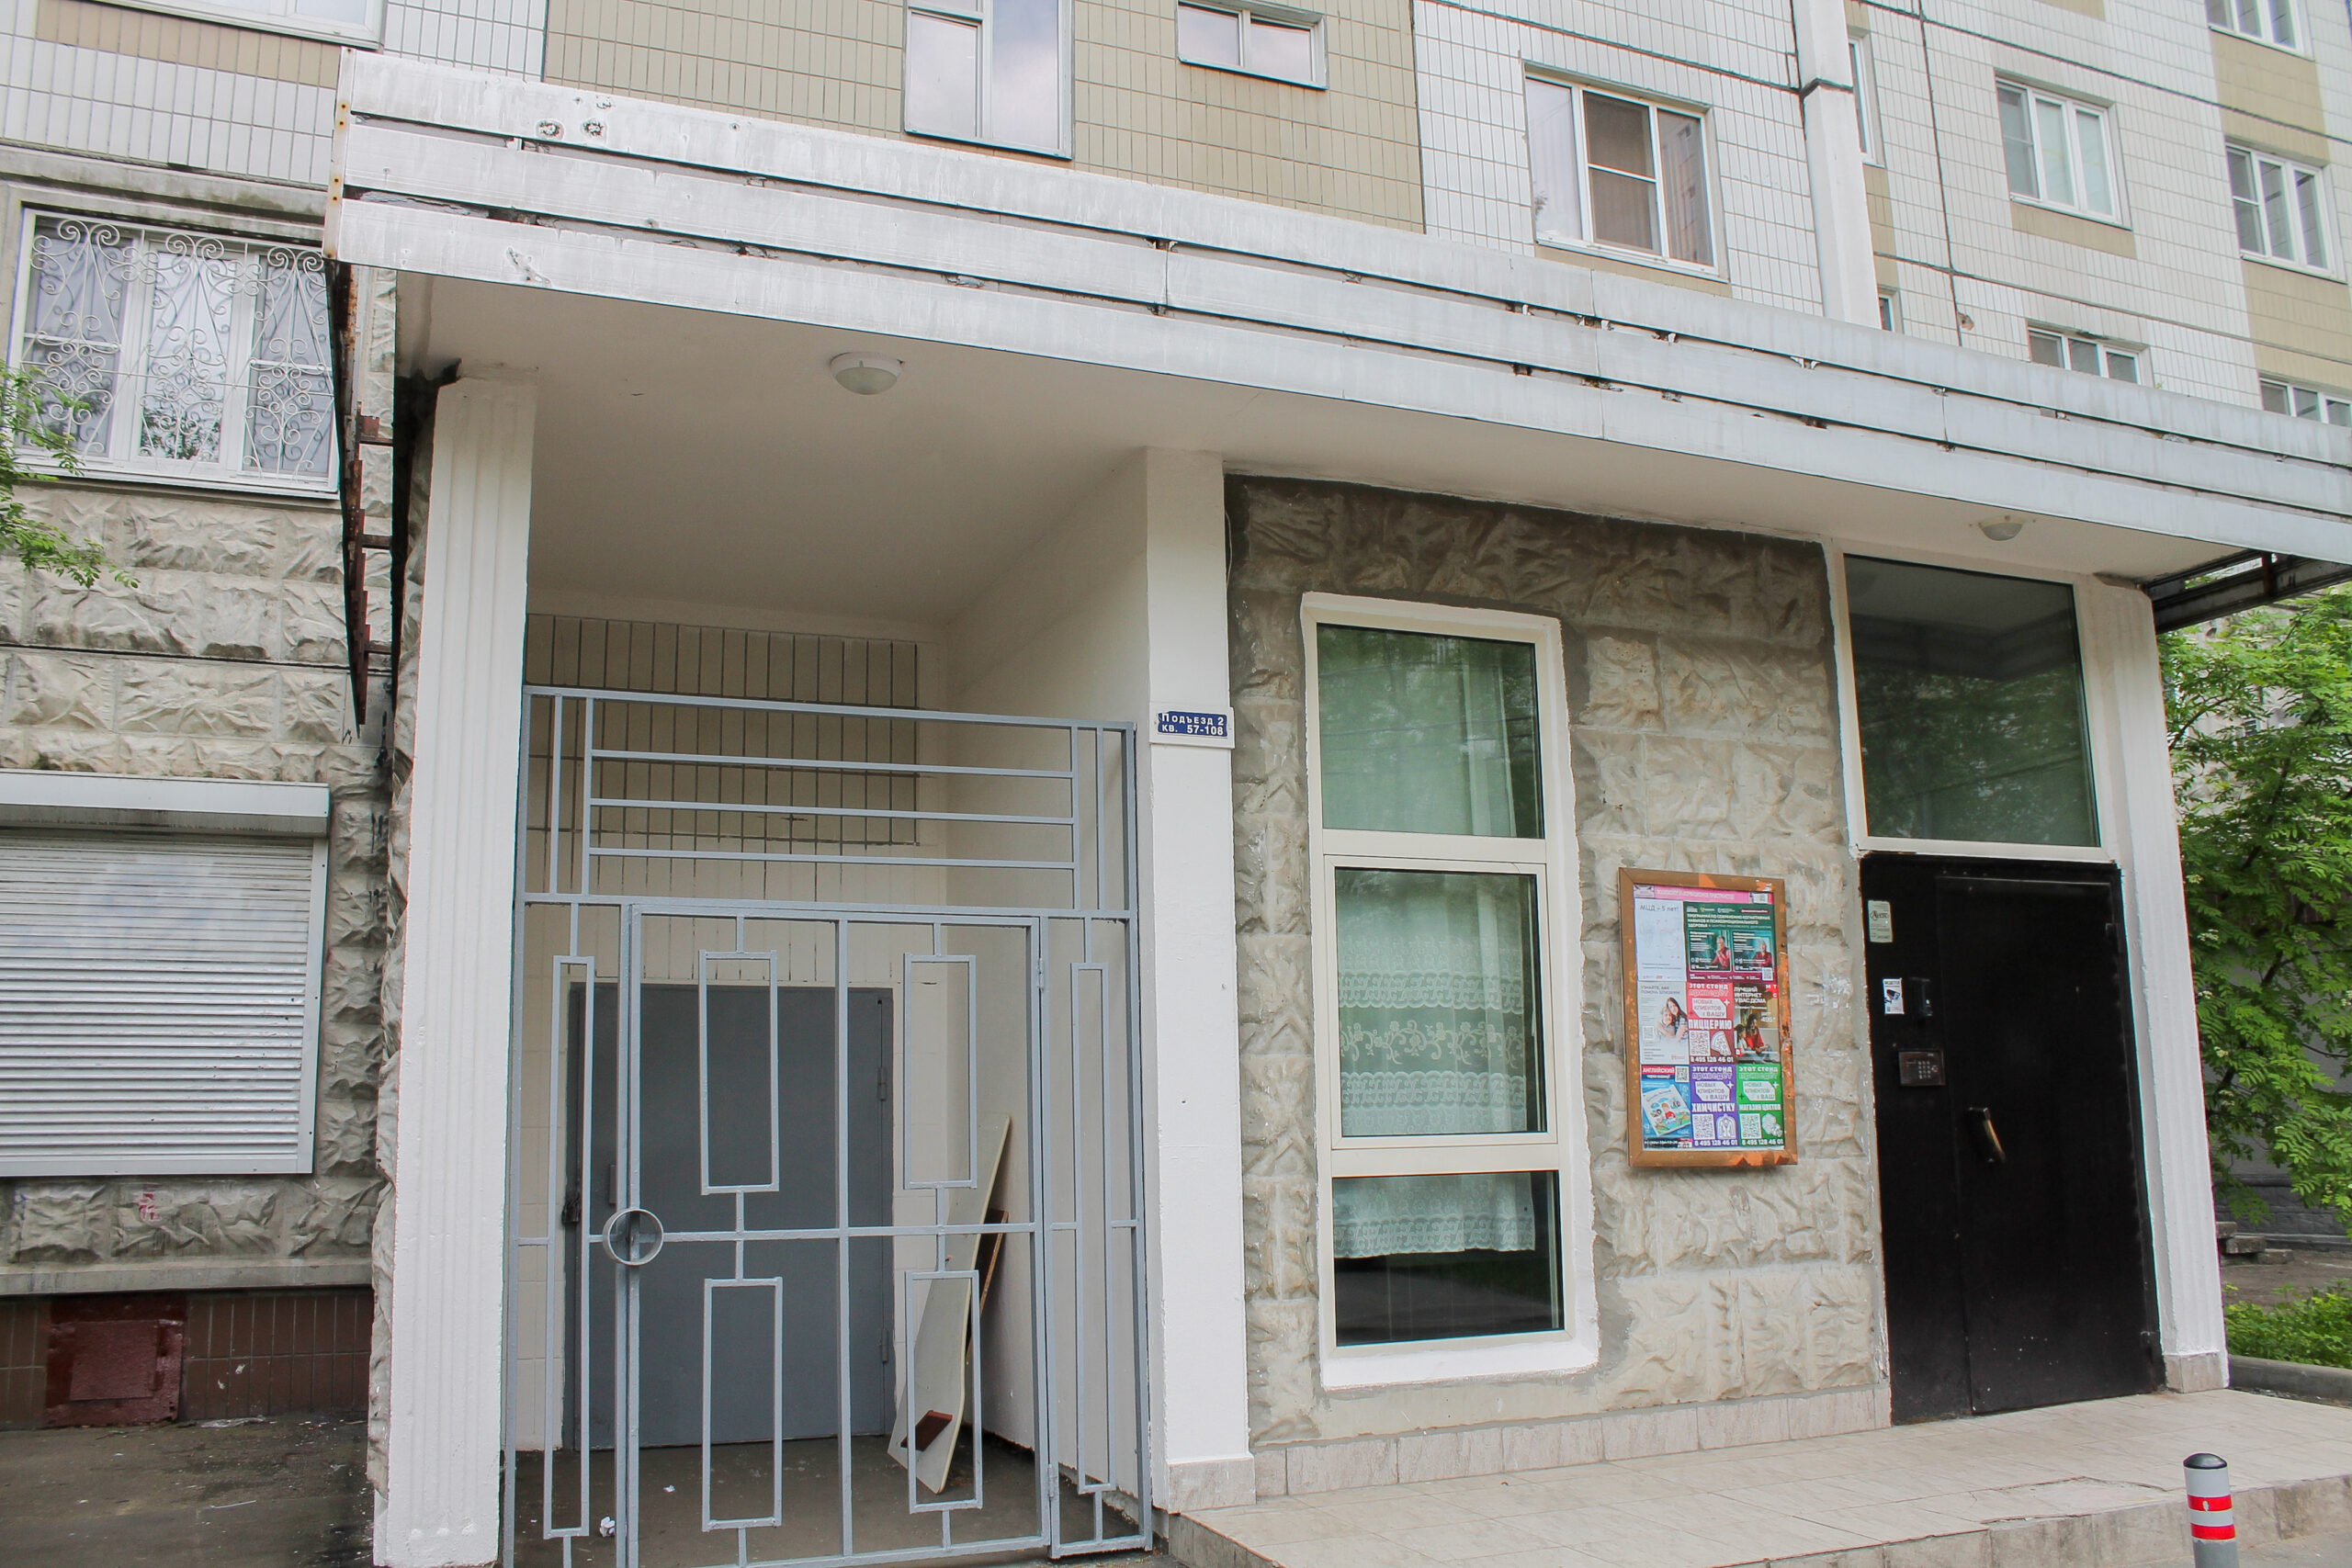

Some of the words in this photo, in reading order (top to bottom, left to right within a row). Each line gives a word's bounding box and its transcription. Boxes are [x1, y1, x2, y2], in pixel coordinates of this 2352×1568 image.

[1218, 716, 1224, 726] 2
[1187, 725, 1224, 735] 57-108
[1689, 1020, 1732, 1030] ПИЦЦЕРИЮ
[1691, 1103, 1736, 1112] ХИМЧИСТКУ
